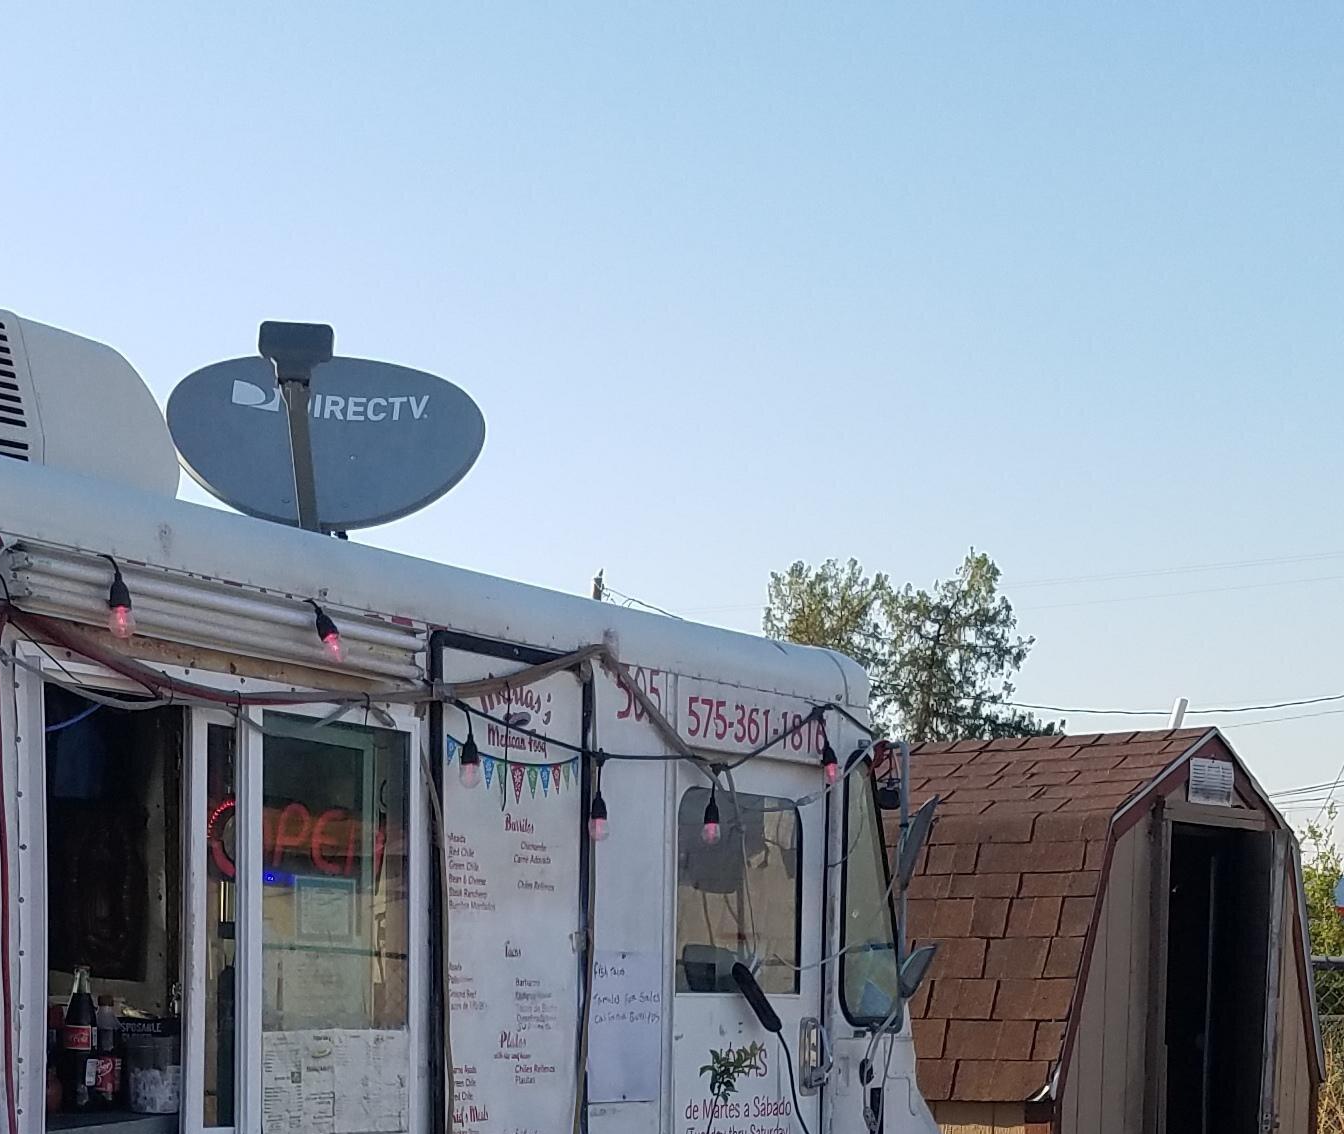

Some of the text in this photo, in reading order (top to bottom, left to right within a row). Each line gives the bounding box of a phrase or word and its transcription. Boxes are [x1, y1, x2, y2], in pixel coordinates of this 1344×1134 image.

[308, 394, 429, 421] IRECTV
[685, 1095, 792, 1120] de Martes a Sábado
